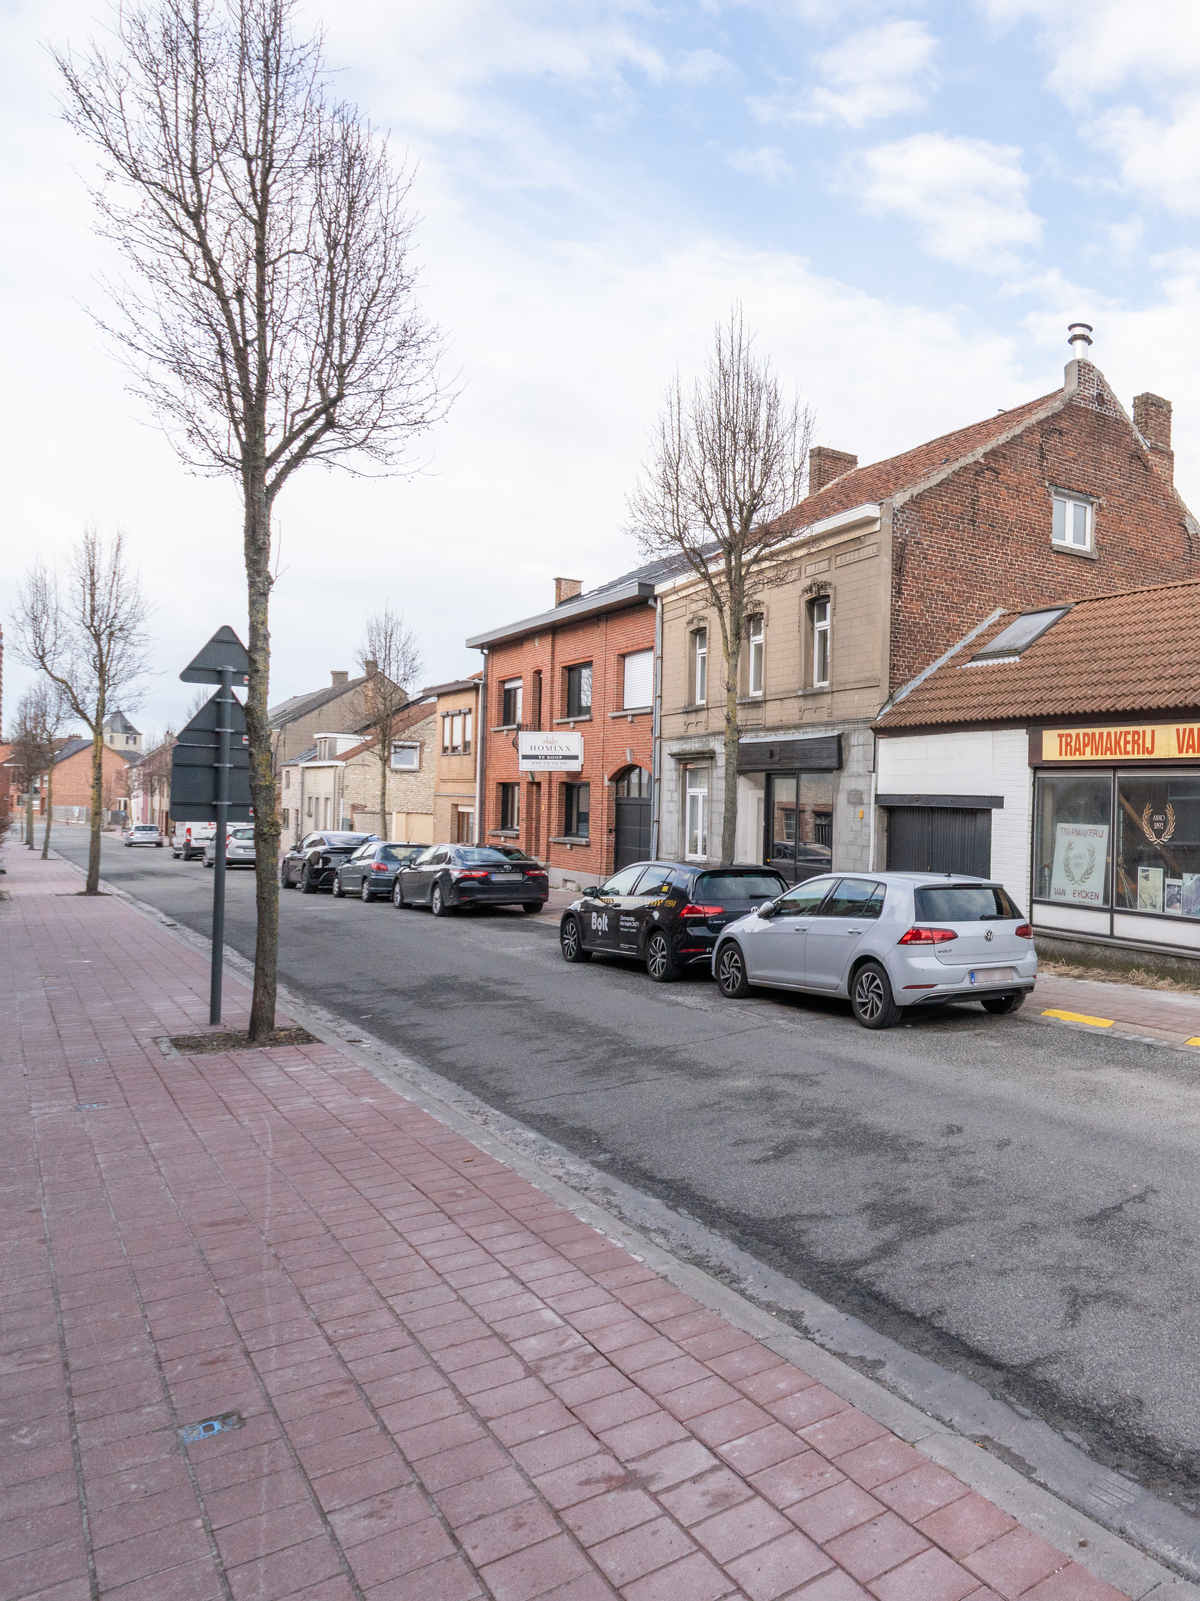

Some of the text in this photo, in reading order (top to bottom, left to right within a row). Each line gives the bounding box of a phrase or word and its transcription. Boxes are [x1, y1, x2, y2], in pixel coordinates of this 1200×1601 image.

[1057, 729, 1156, 757] TRAPMAKERIJ
[1060, 827, 1104, 838] TRAPMAKERIJ
[1054, 887, 1100, 901] VAN EYCKEN
[591, 912, 609, 932] Bolt
